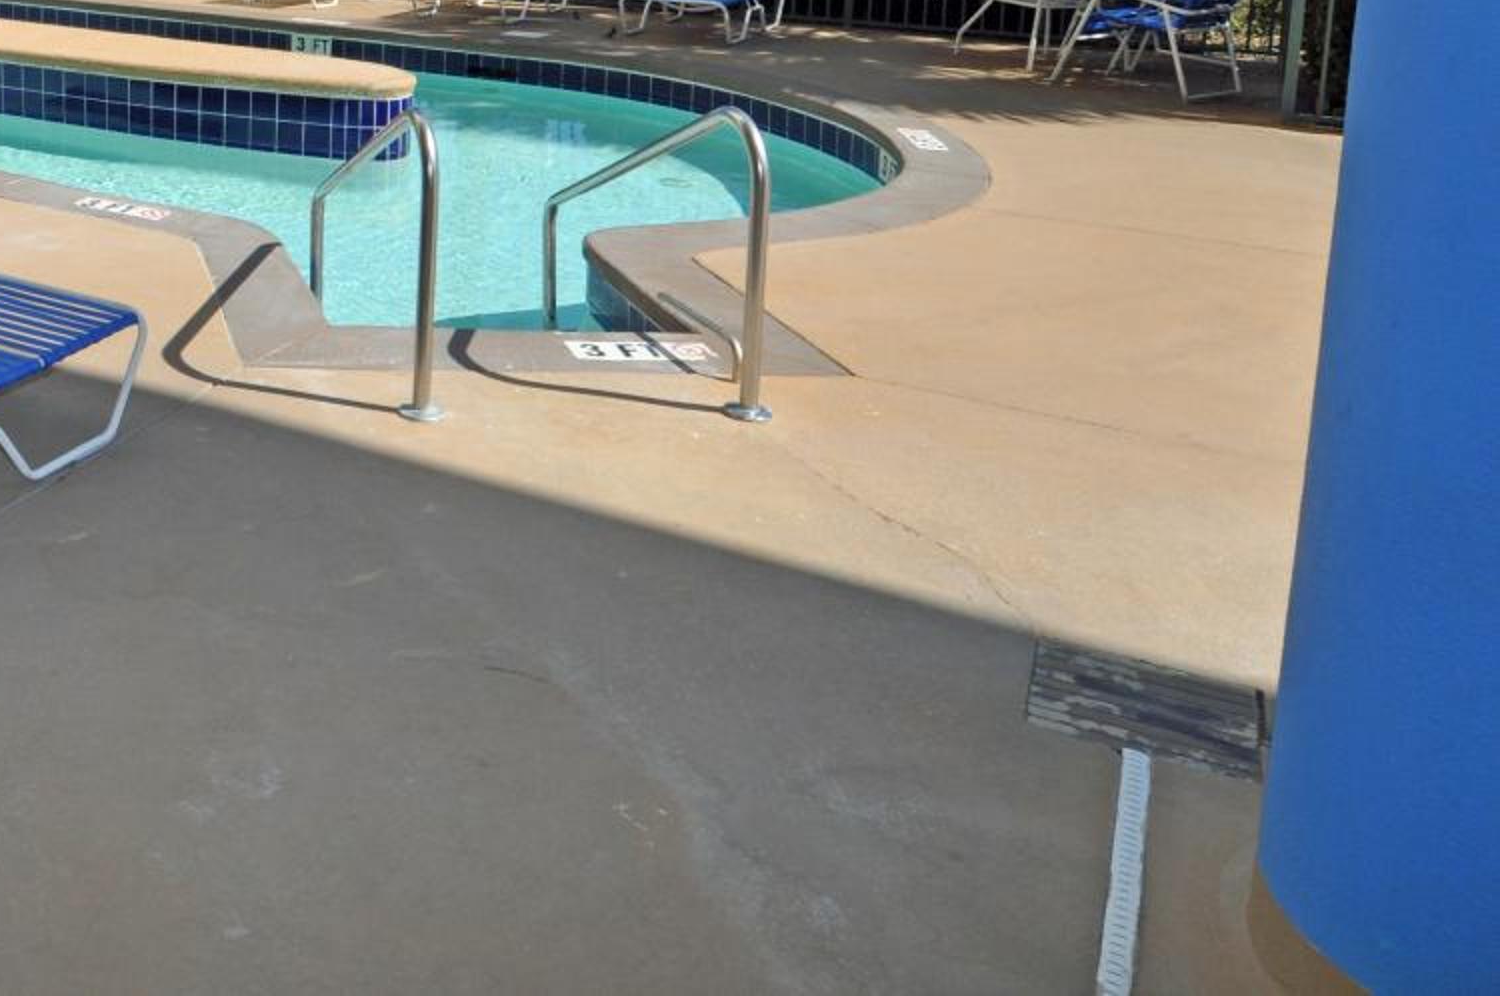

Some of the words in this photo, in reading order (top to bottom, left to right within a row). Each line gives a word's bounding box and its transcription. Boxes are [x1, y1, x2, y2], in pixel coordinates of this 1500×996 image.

[296, 36, 305, 52] 3
[313, 38, 330, 55] FT
[579, 343, 605, 357] 3
[616, 343, 661, 358] FT
